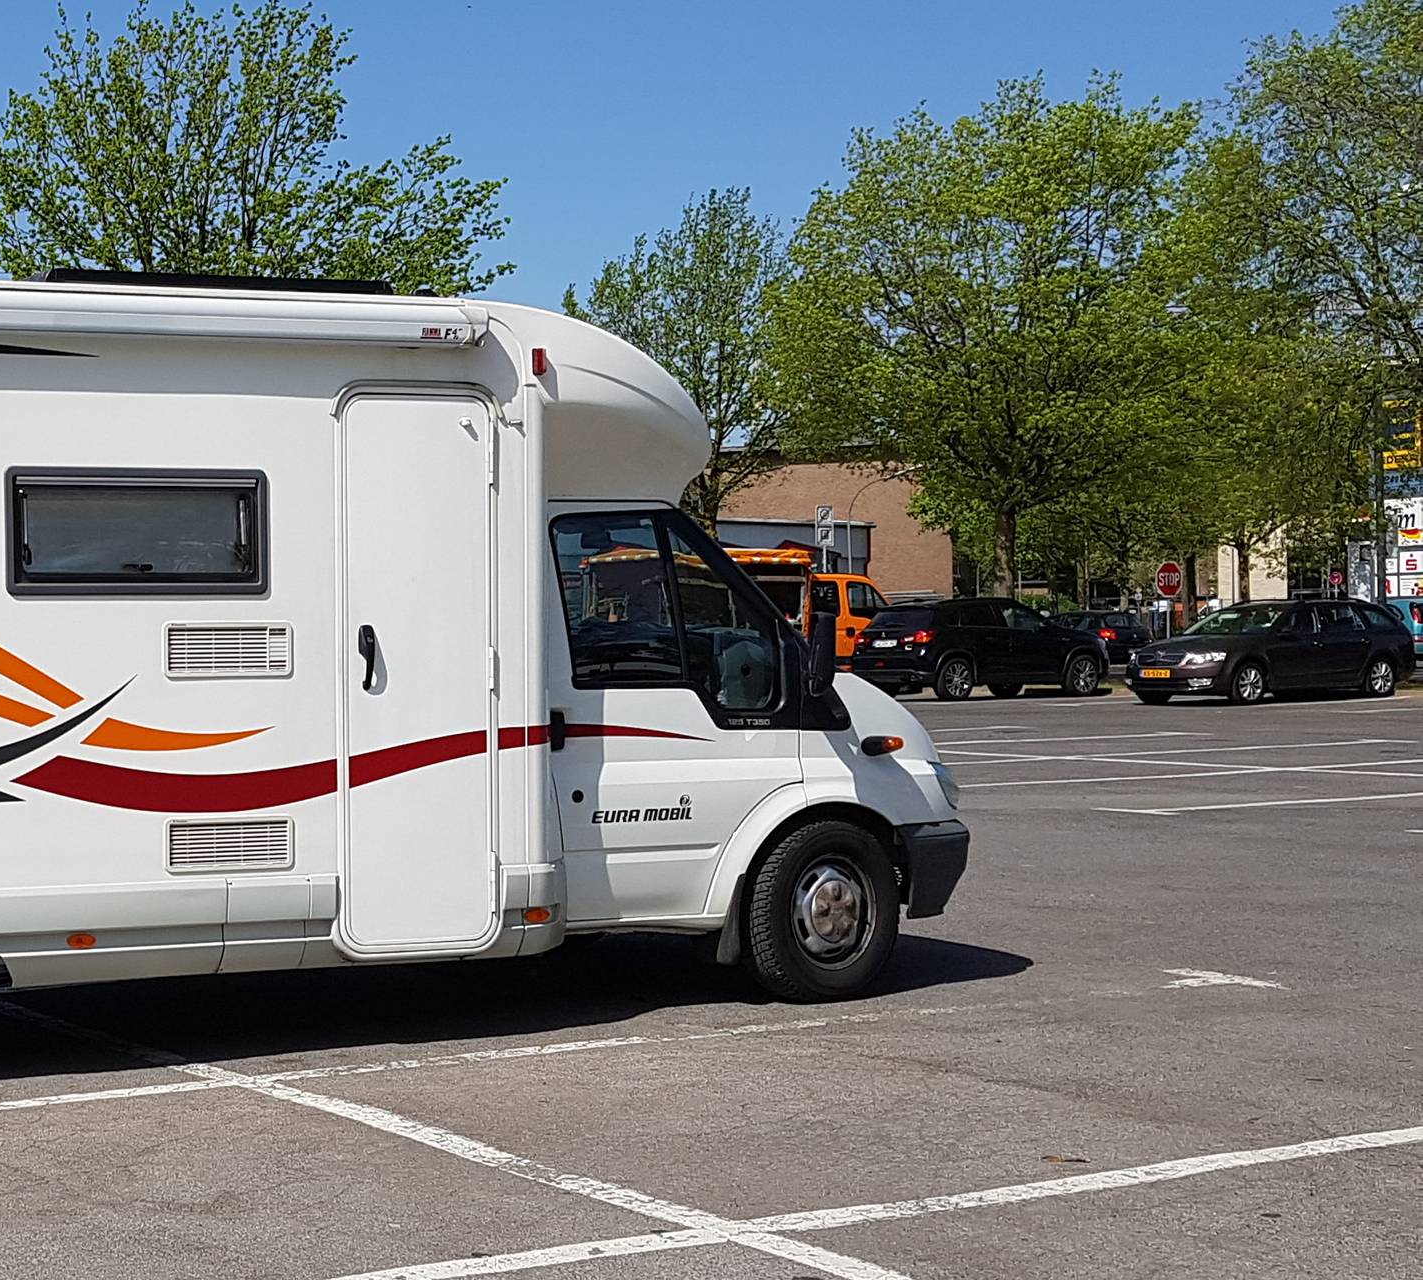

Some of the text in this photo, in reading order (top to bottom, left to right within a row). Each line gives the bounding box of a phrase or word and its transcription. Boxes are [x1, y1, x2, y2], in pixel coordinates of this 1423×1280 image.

[1158, 572, 1180, 587] STOP
[745, 718, 771, 726] T350
[591, 806, 693, 824] EURA MOBIL
